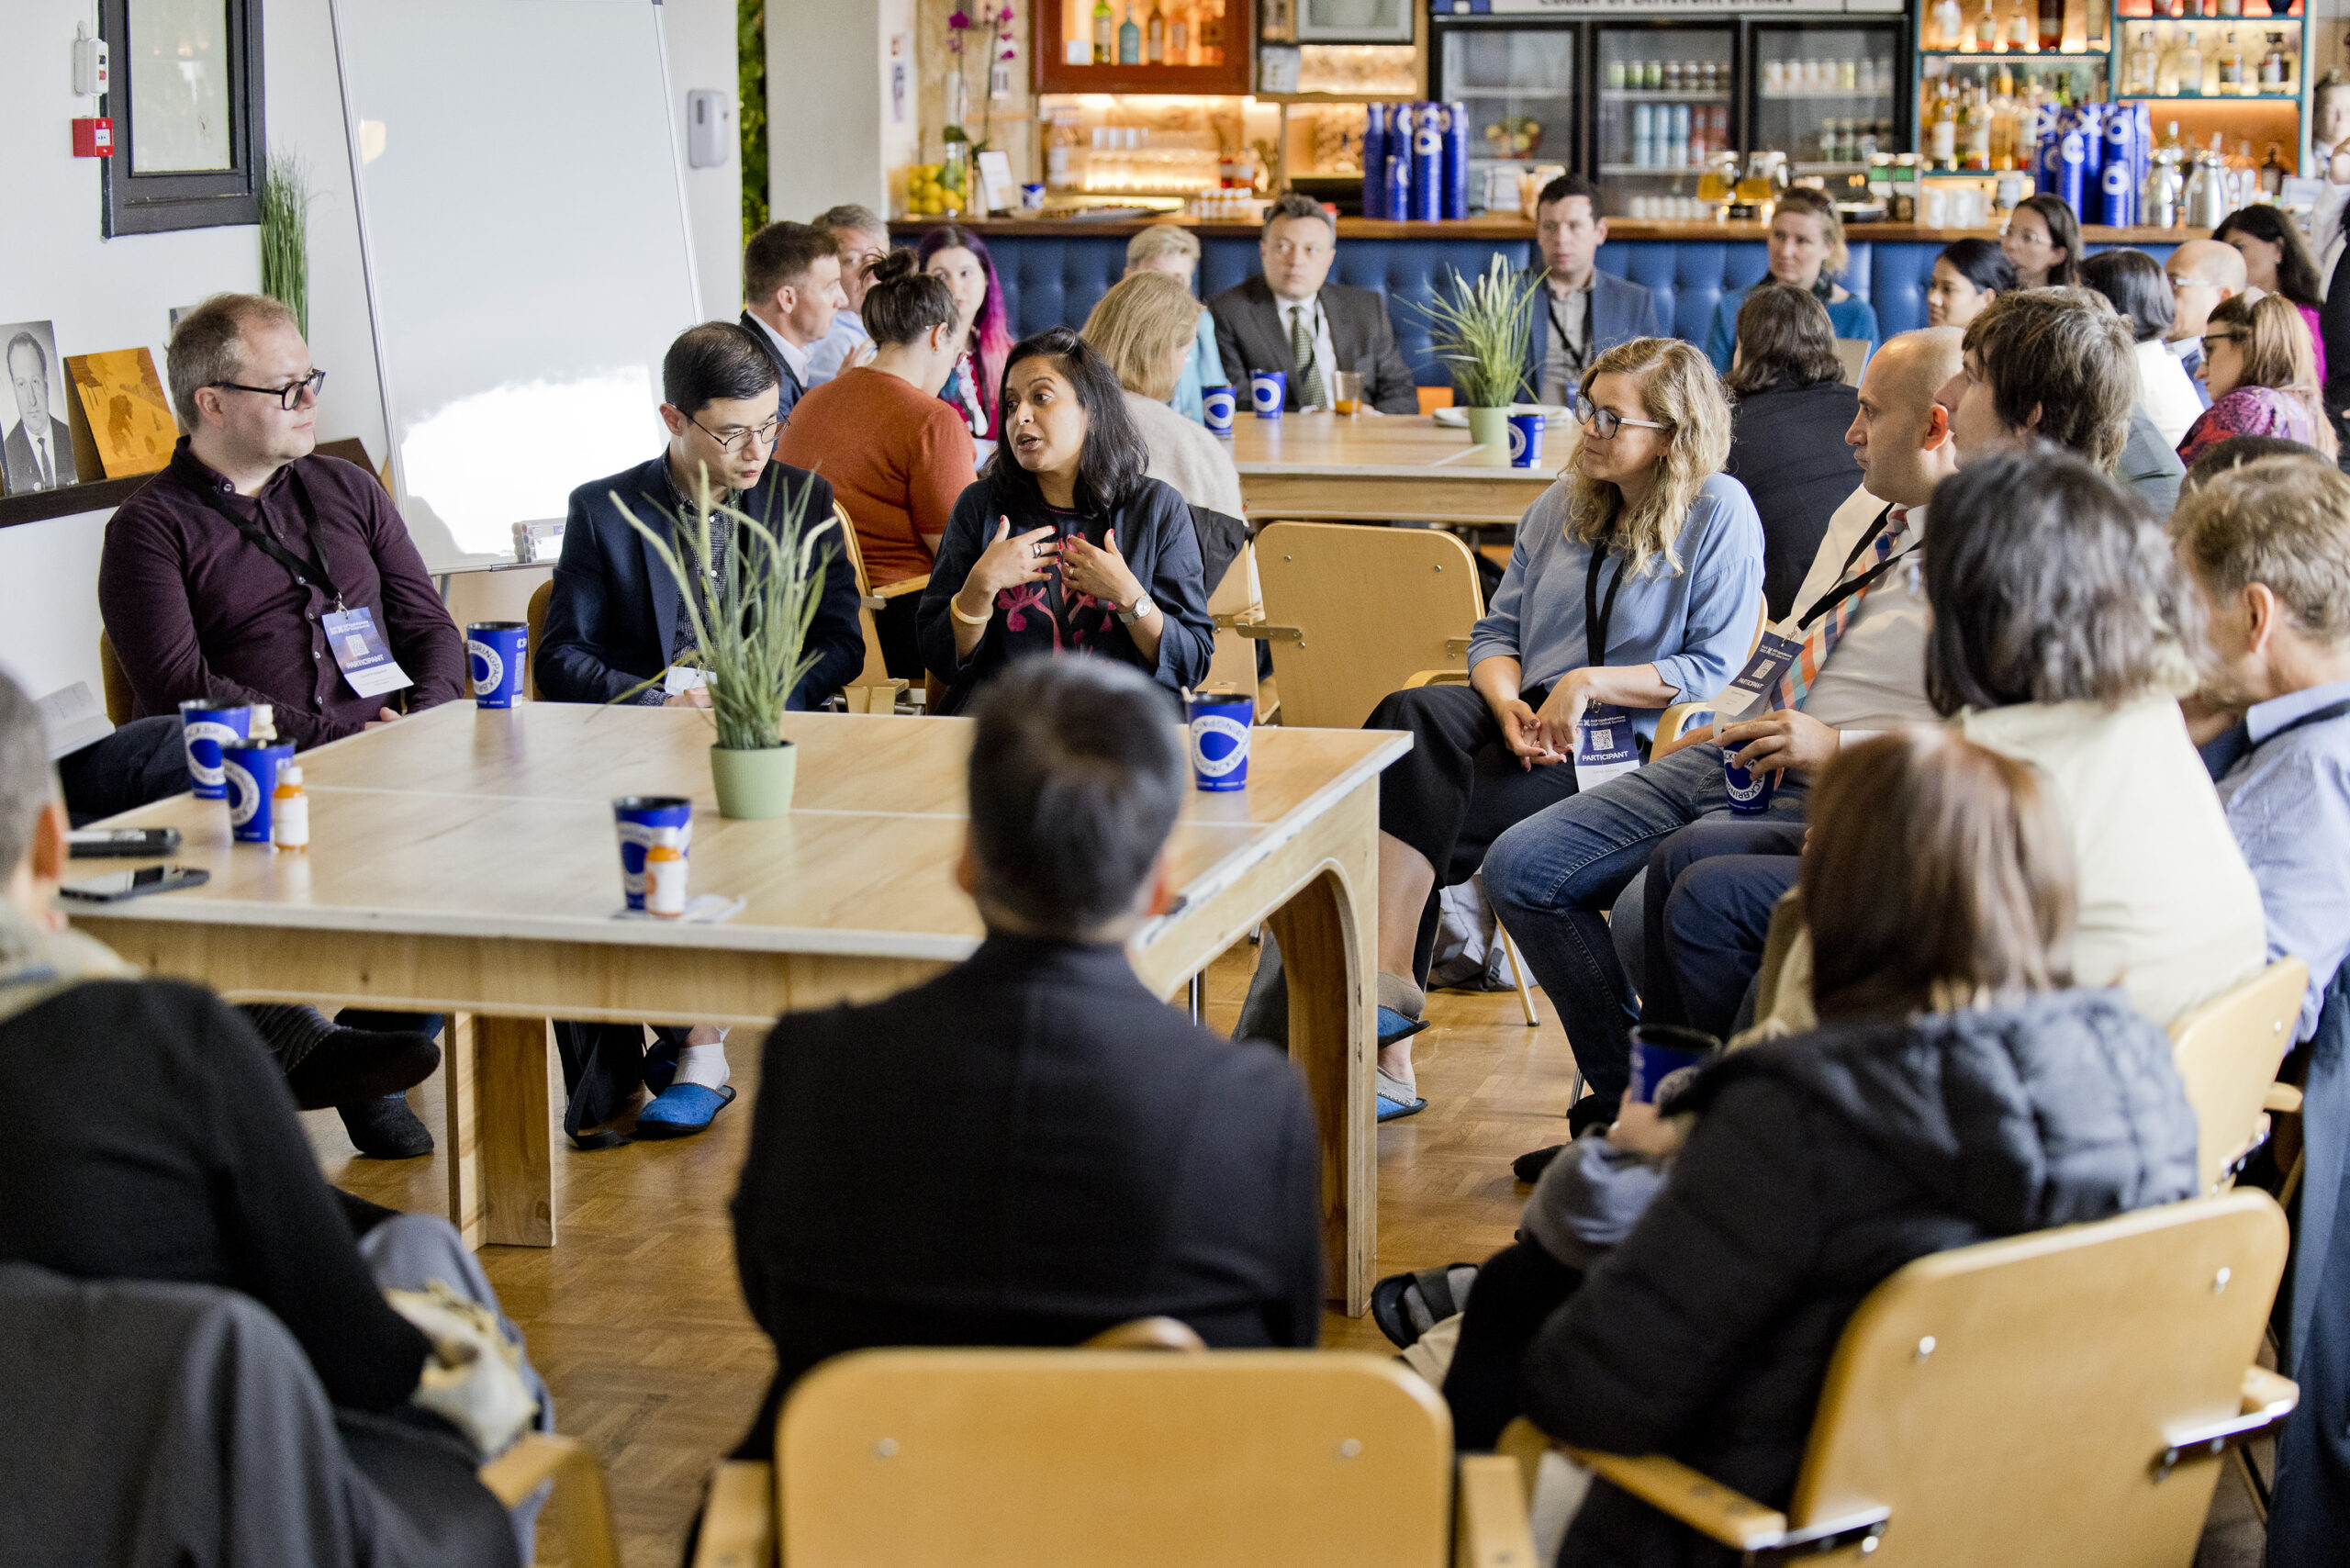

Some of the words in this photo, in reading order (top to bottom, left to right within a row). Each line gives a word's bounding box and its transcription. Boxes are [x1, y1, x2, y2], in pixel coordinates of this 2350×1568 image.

[345, 655, 385, 668] PARTICIPANT
[1737, 678, 1764, 689] PARTICIPANT
[1582, 751, 1628, 761] PARTICIPANT
